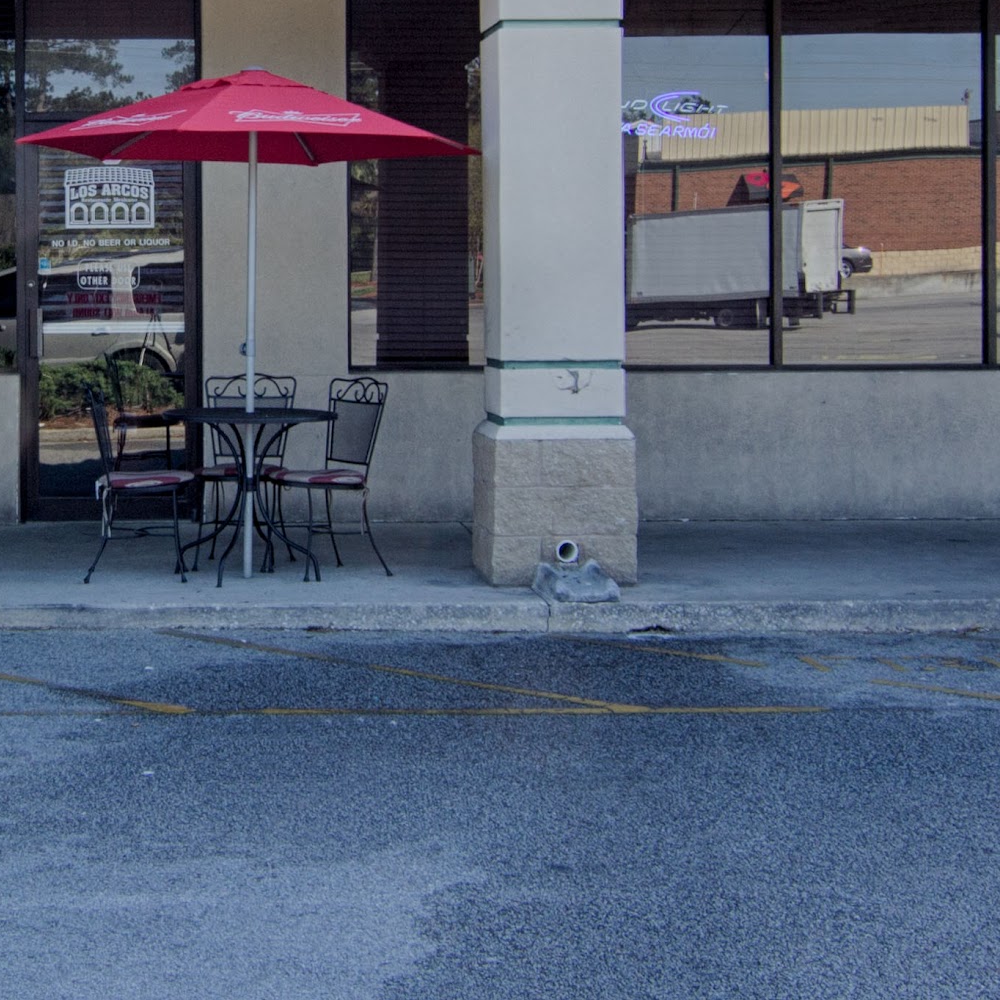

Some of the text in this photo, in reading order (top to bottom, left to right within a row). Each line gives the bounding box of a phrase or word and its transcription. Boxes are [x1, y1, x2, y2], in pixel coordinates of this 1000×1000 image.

[621, 100, 729, 114] UD LIGHT
[70, 183, 149, 201] LOS ARCOS
[51, 239, 65, 248] NO
[83, 239, 96, 247] NO
[99, 238, 121, 247] BEER
[123, 238, 136, 246] OR
[139, 237, 171, 247] LIQUOR
[80, 275, 137, 286] OTHER DOOR
